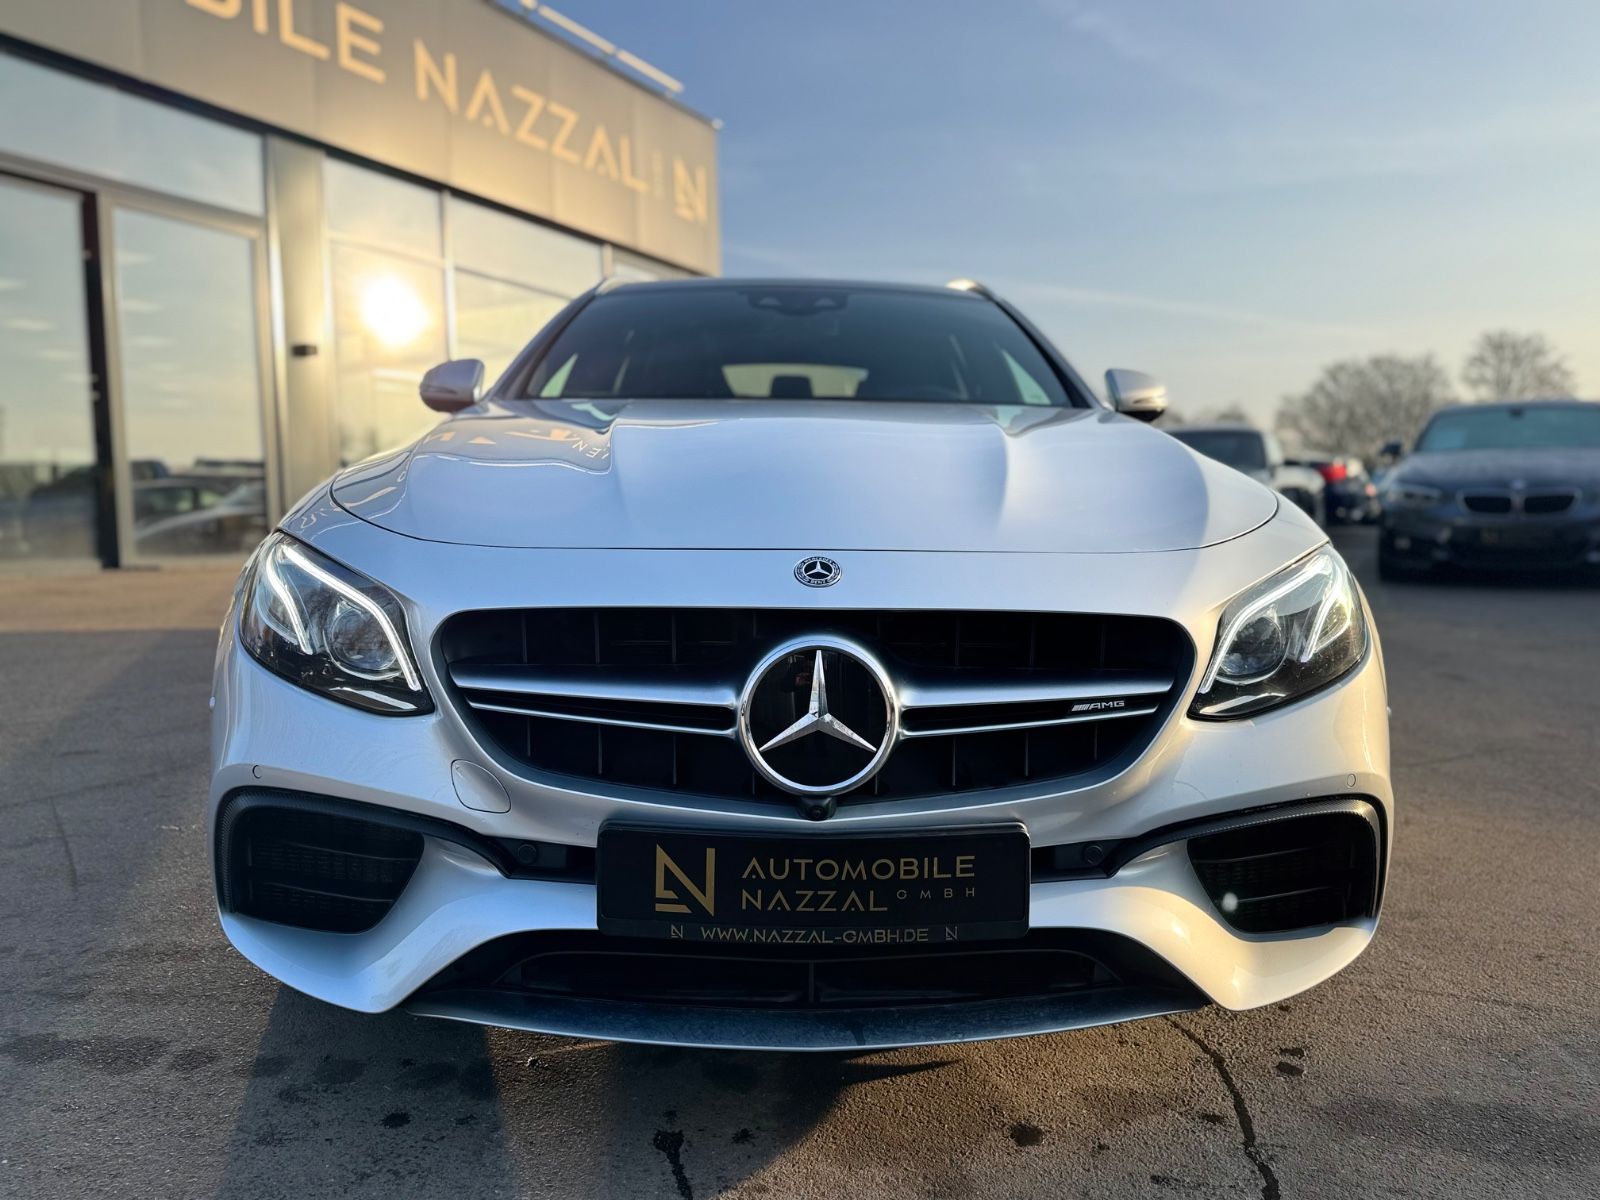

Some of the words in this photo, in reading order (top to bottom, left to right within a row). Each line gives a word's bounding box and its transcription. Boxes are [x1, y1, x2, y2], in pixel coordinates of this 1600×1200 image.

[413, 38, 650, 193] NAZZAL
[741, 855, 976, 881] AUTOMOBILE
[741, 889, 888, 912] NAZZAL
[896, 887, 976, 900] GMBH
[701, 927, 929, 944] WWW.NAZZAL-GMBH.DE
